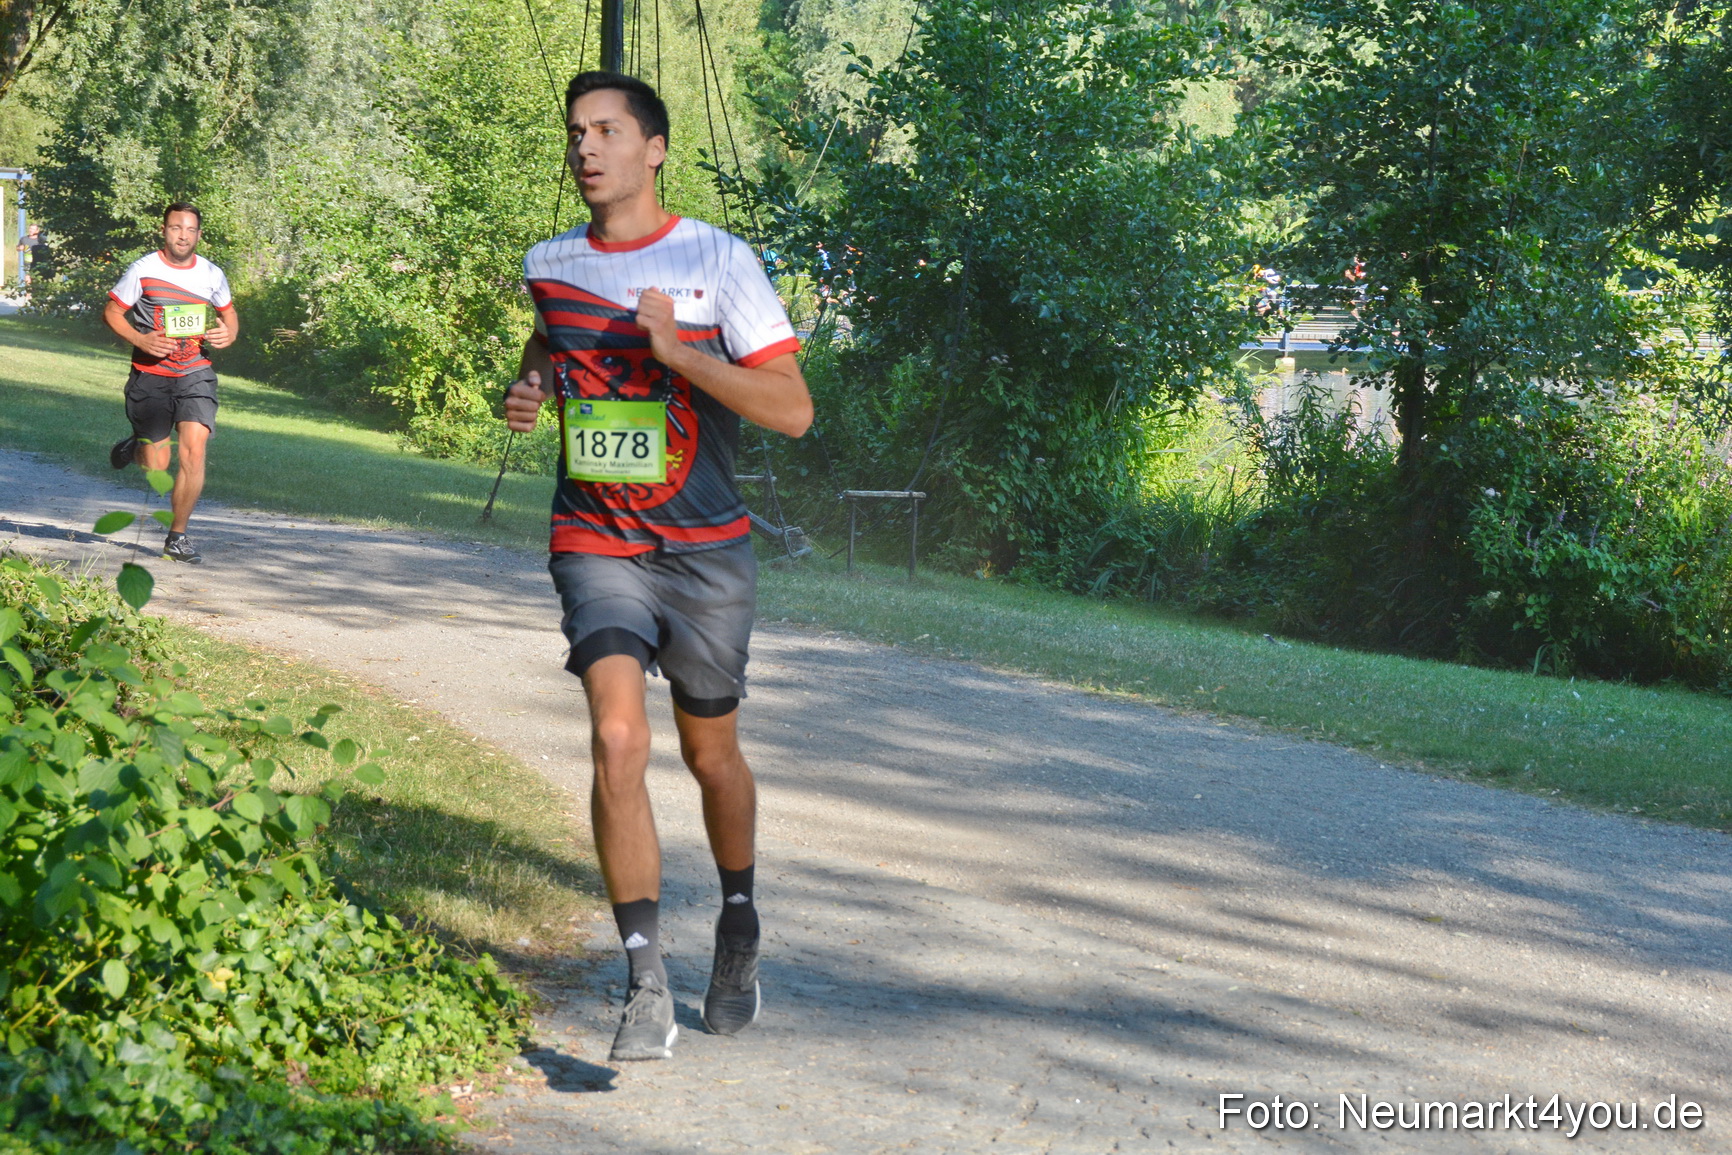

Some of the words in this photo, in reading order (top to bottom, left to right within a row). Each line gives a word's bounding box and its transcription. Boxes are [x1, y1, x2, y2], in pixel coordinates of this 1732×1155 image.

[627, 287, 691, 297] NEARKT
[171, 315, 200, 327] 1881
[575, 429, 650, 459] 1878
[574, 459, 607, 468] Kaminsky
